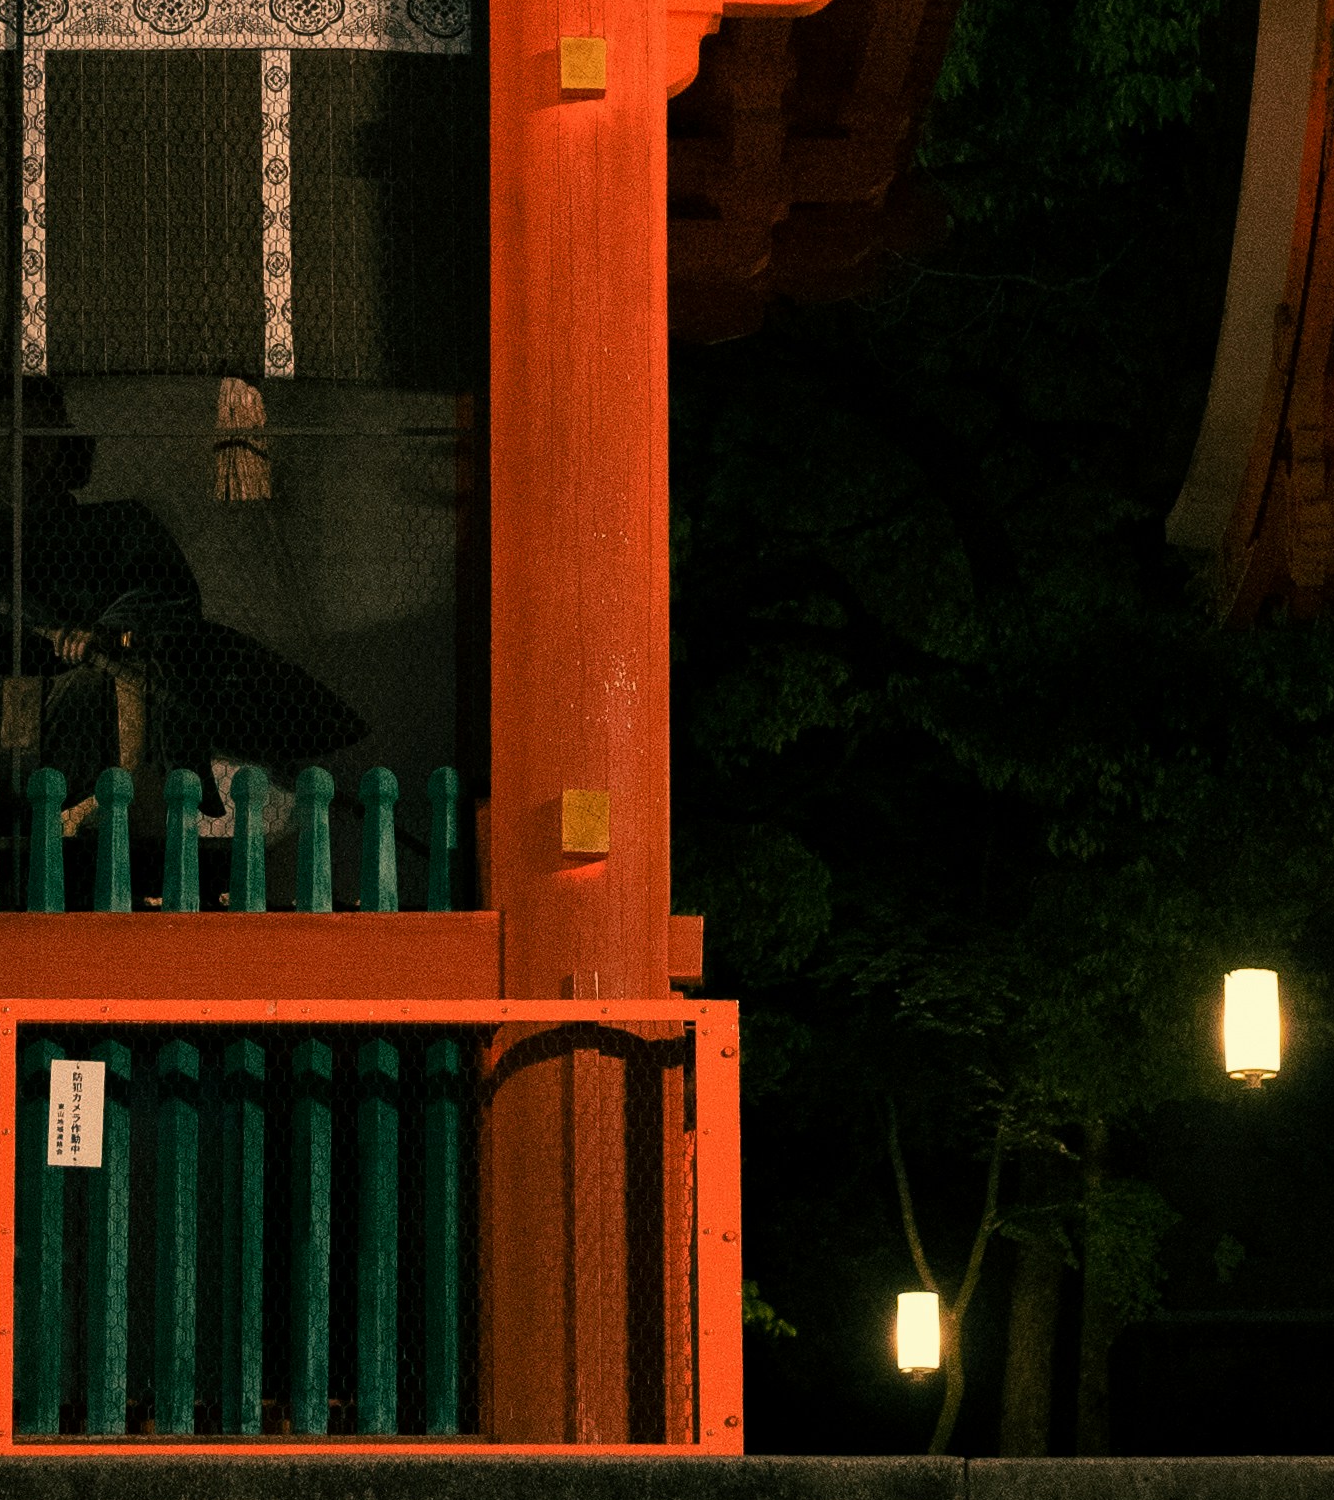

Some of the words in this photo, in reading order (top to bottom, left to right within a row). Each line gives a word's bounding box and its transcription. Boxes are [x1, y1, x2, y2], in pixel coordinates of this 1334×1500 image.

[71, 1072, 82, 1154] 防犯カメラ作動中
